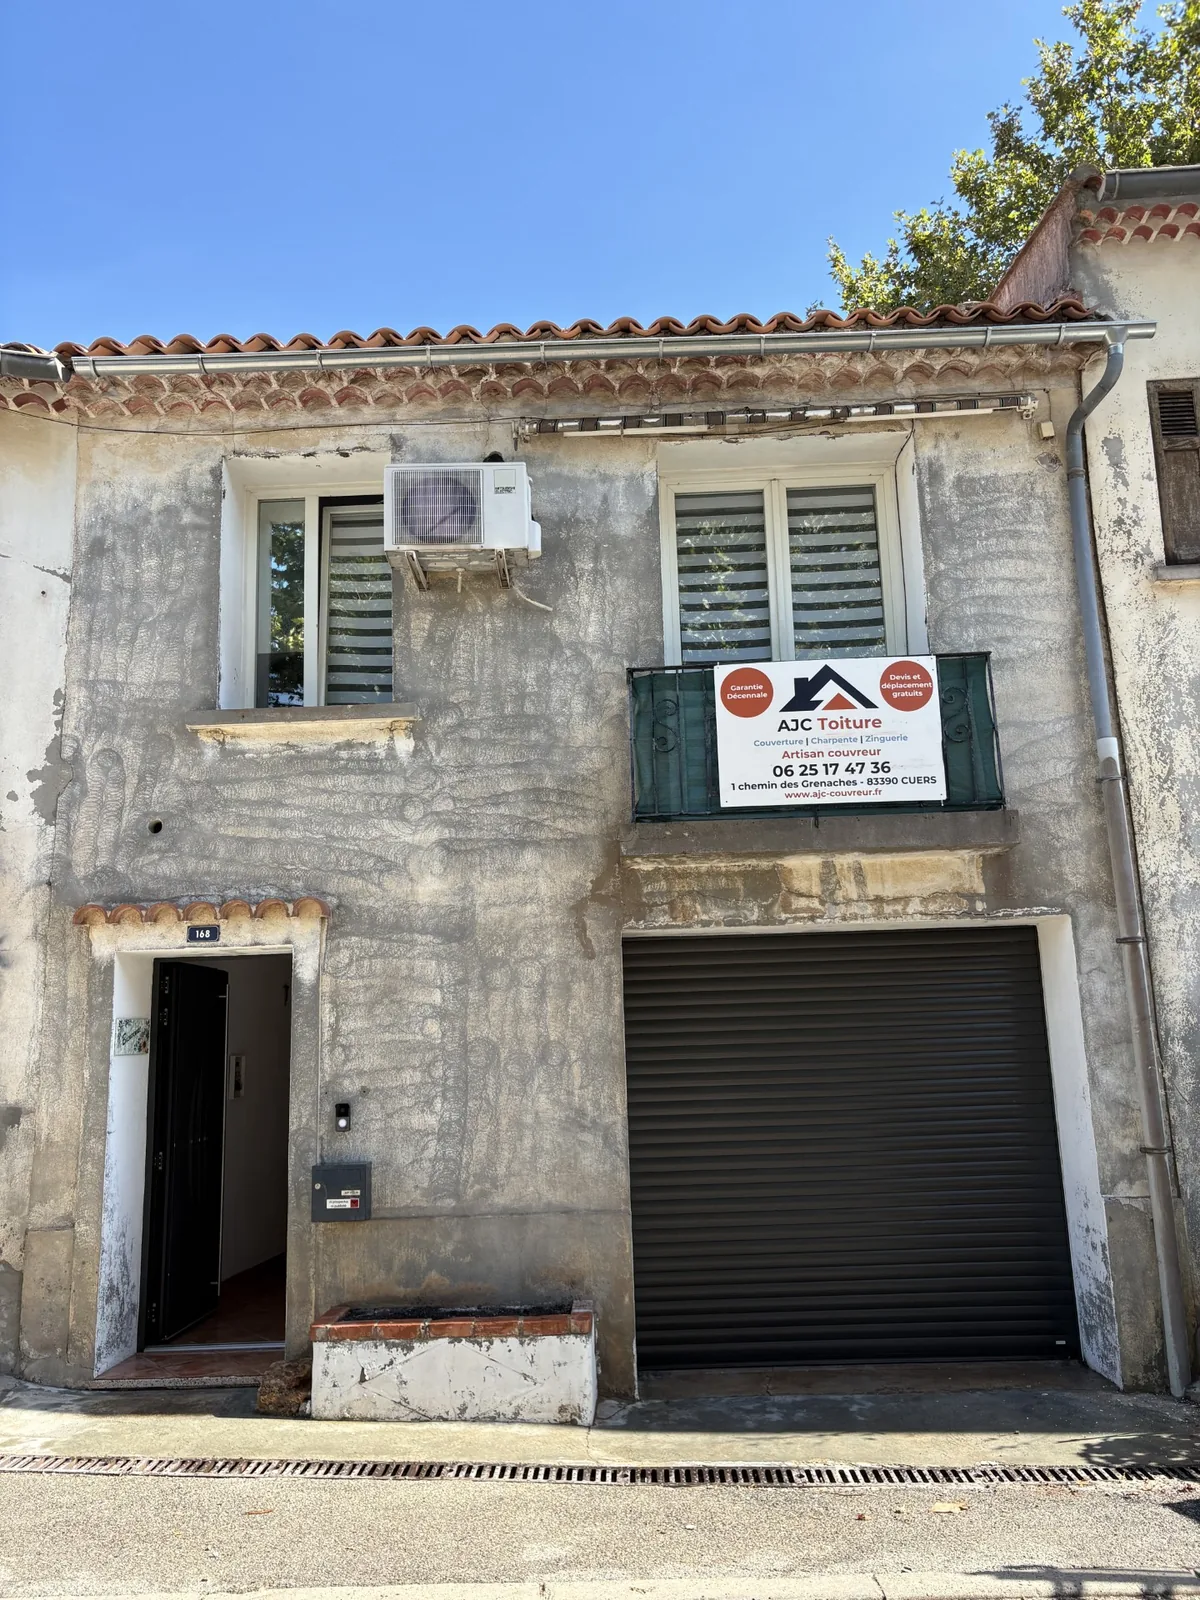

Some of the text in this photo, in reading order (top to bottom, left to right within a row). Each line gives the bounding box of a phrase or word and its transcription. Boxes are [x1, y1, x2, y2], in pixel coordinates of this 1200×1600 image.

[730, 683, 764, 691] Garantie
[881, 681, 933, 690] déplacement
[891, 690, 923, 698] gratuits
[777, 716, 882, 732] AJC Toiture
[753, 738, 804, 747] Couverture
[810, 736, 858, 745] Charpente
[865, 734, 909, 743] Zinguerie
[781, 748, 882, 759] Artisan couvreur
[772, 761, 891, 778] 06 25 17 47 36
[730, 783, 735, 791] 1
[738, 781, 777, 791] chemin
[780, 780, 799, 789] des
[801, 778, 858, 788] Grenaches
[866, 777, 899, 786] 83390
[901, 776, 937, 785] CUERS
[784, 787, 882, 799] www.ajc-couvreur.fr
[195, 929, 211, 939] 168
